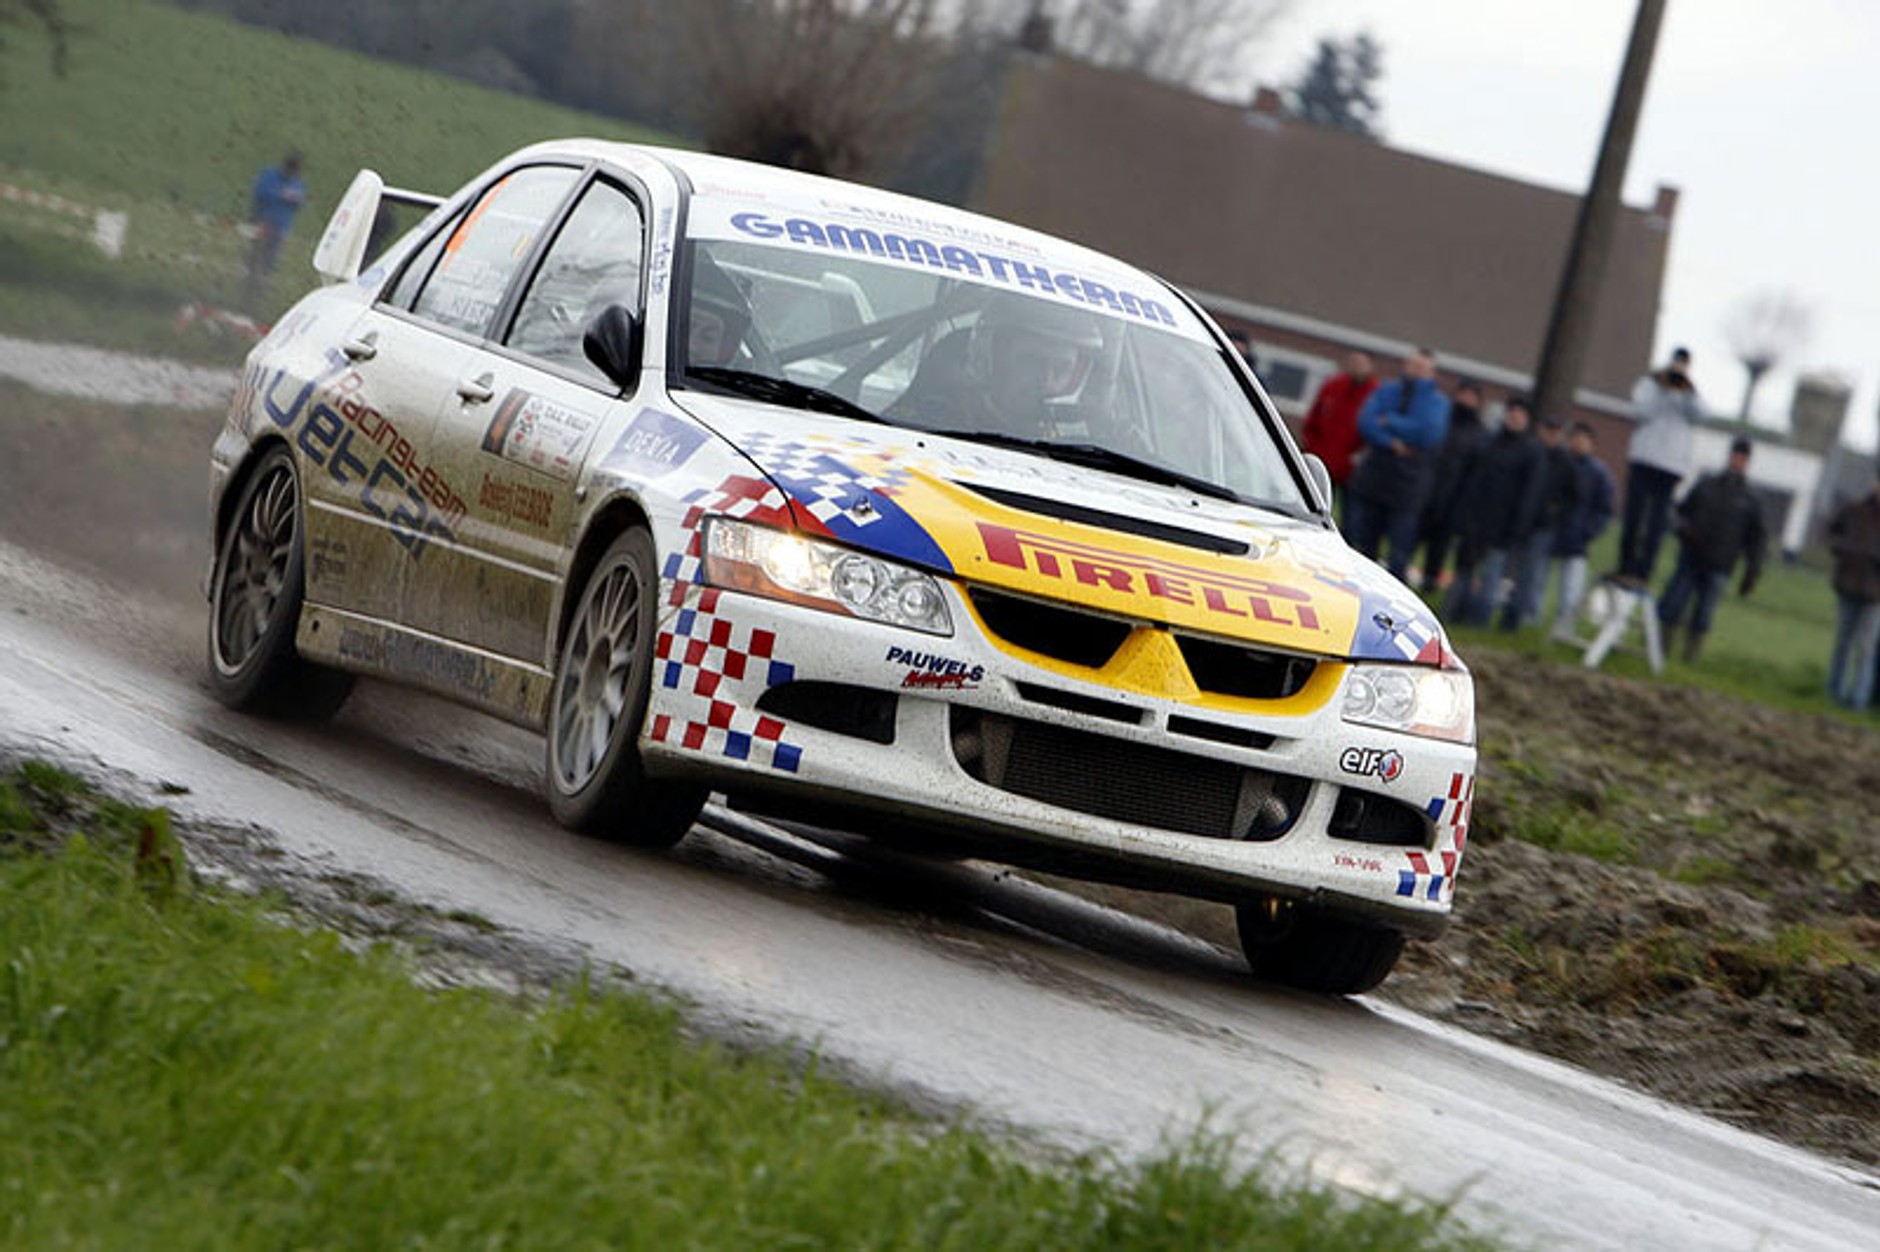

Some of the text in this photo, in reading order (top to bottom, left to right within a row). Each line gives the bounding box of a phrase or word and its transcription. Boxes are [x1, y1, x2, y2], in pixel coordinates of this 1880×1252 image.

[730, 212, 1178, 328] GAMMATHERM
[975, 522, 1320, 631] PIRELLI
[886, 646, 985, 681] PAUWELS
[1340, 748, 1382, 775] elf
